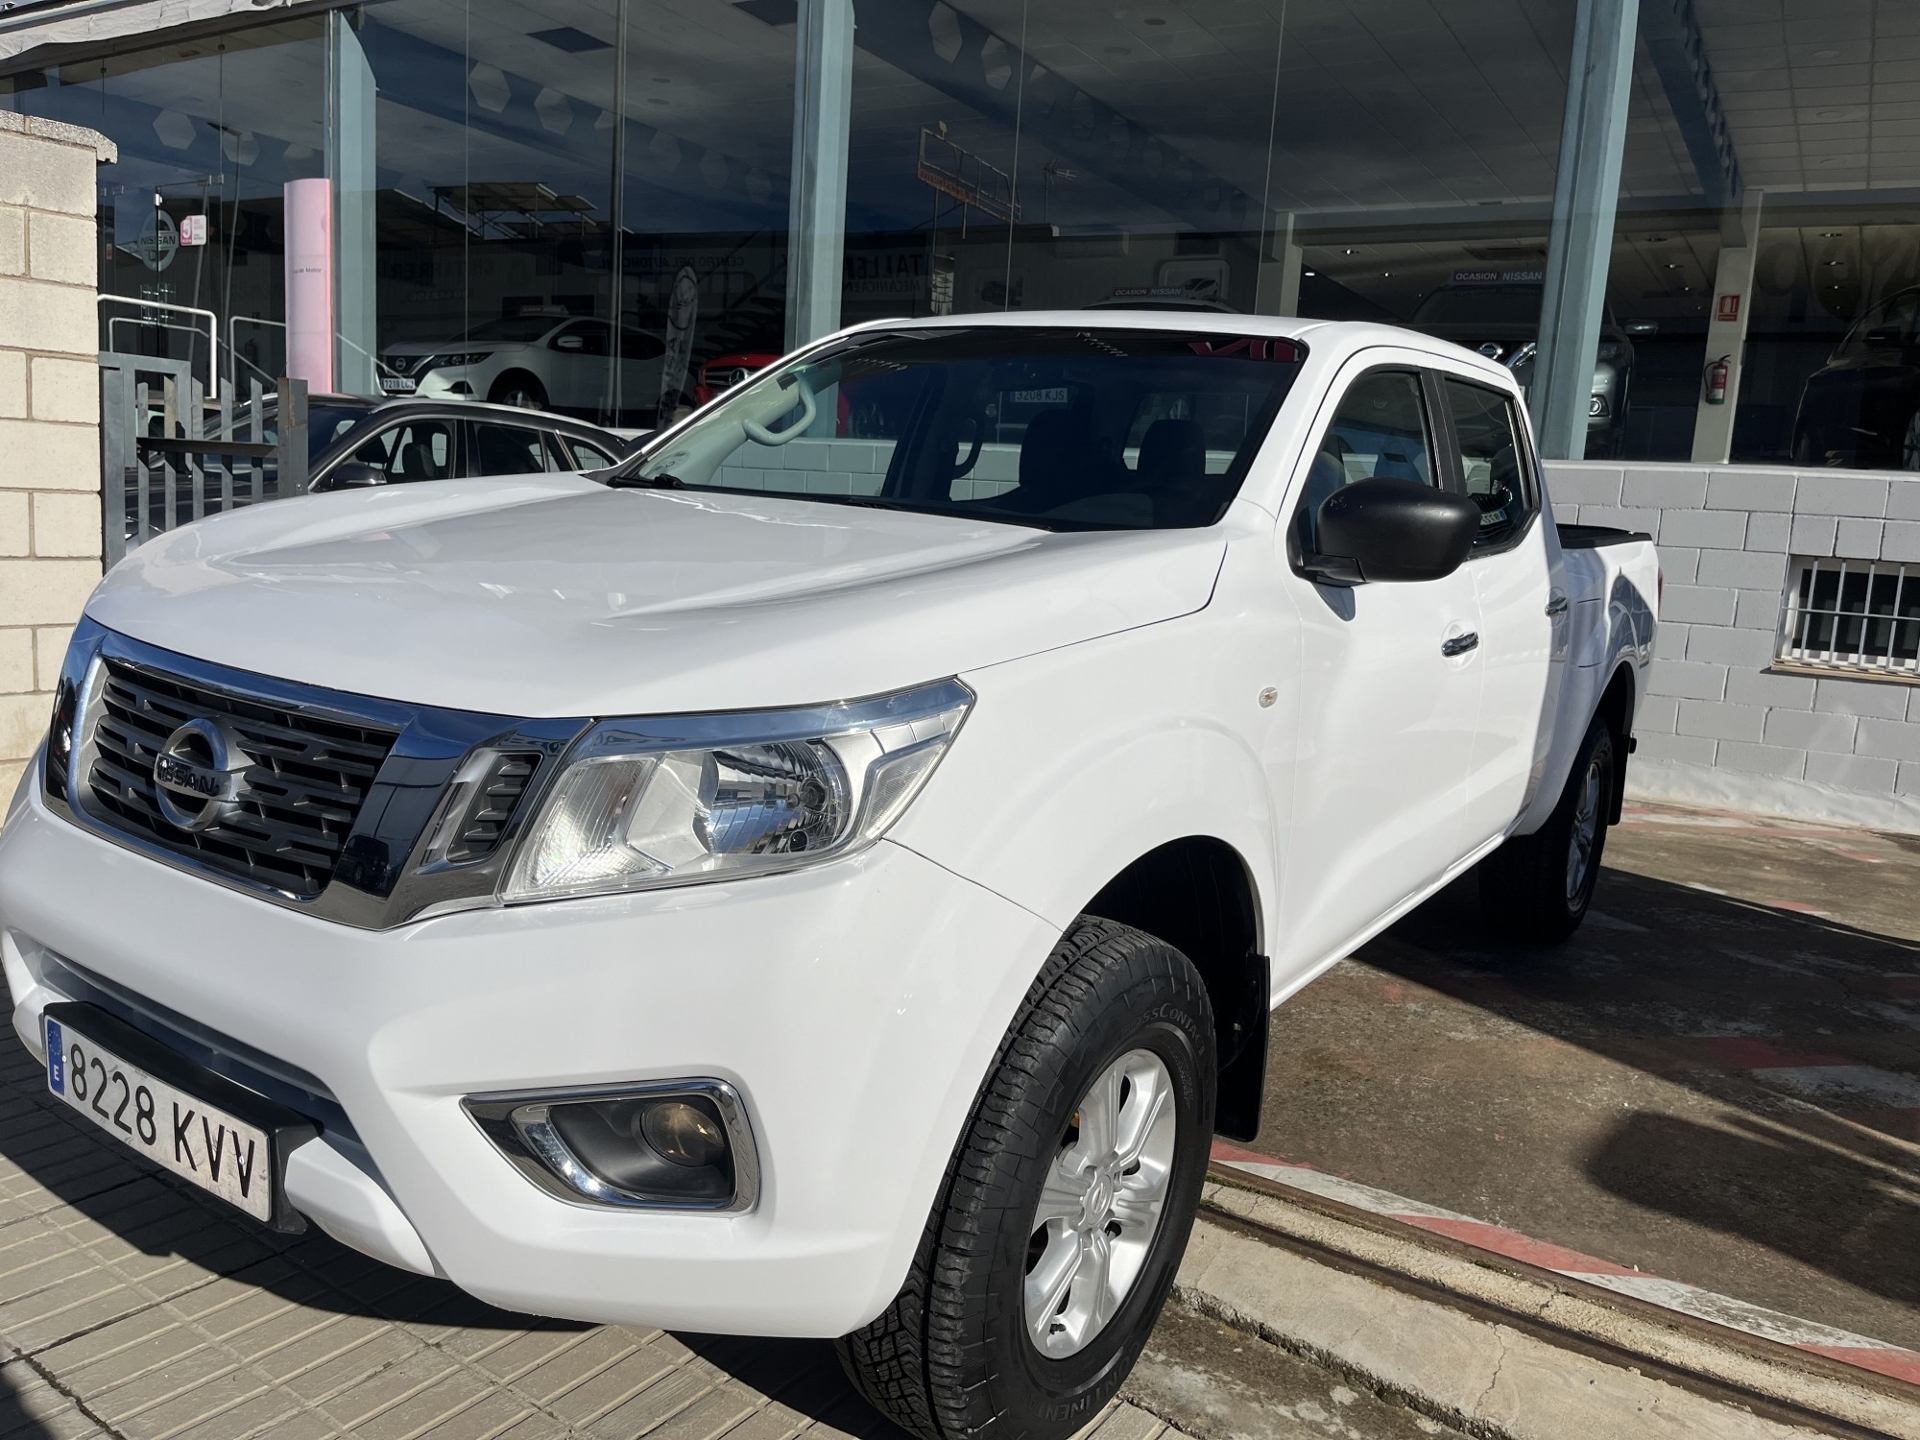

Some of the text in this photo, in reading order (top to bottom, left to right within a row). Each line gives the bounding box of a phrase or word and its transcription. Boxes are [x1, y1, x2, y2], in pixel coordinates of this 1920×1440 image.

[141, 235, 176, 245] NISSAN
[1455, 271, 1543, 281] OCASION NISSAN
[1114, 288, 1182, 296] OCASION NISSAN
[53, 1063, 60, 1082] E
[70, 1042, 256, 1199] 8228 KVV
